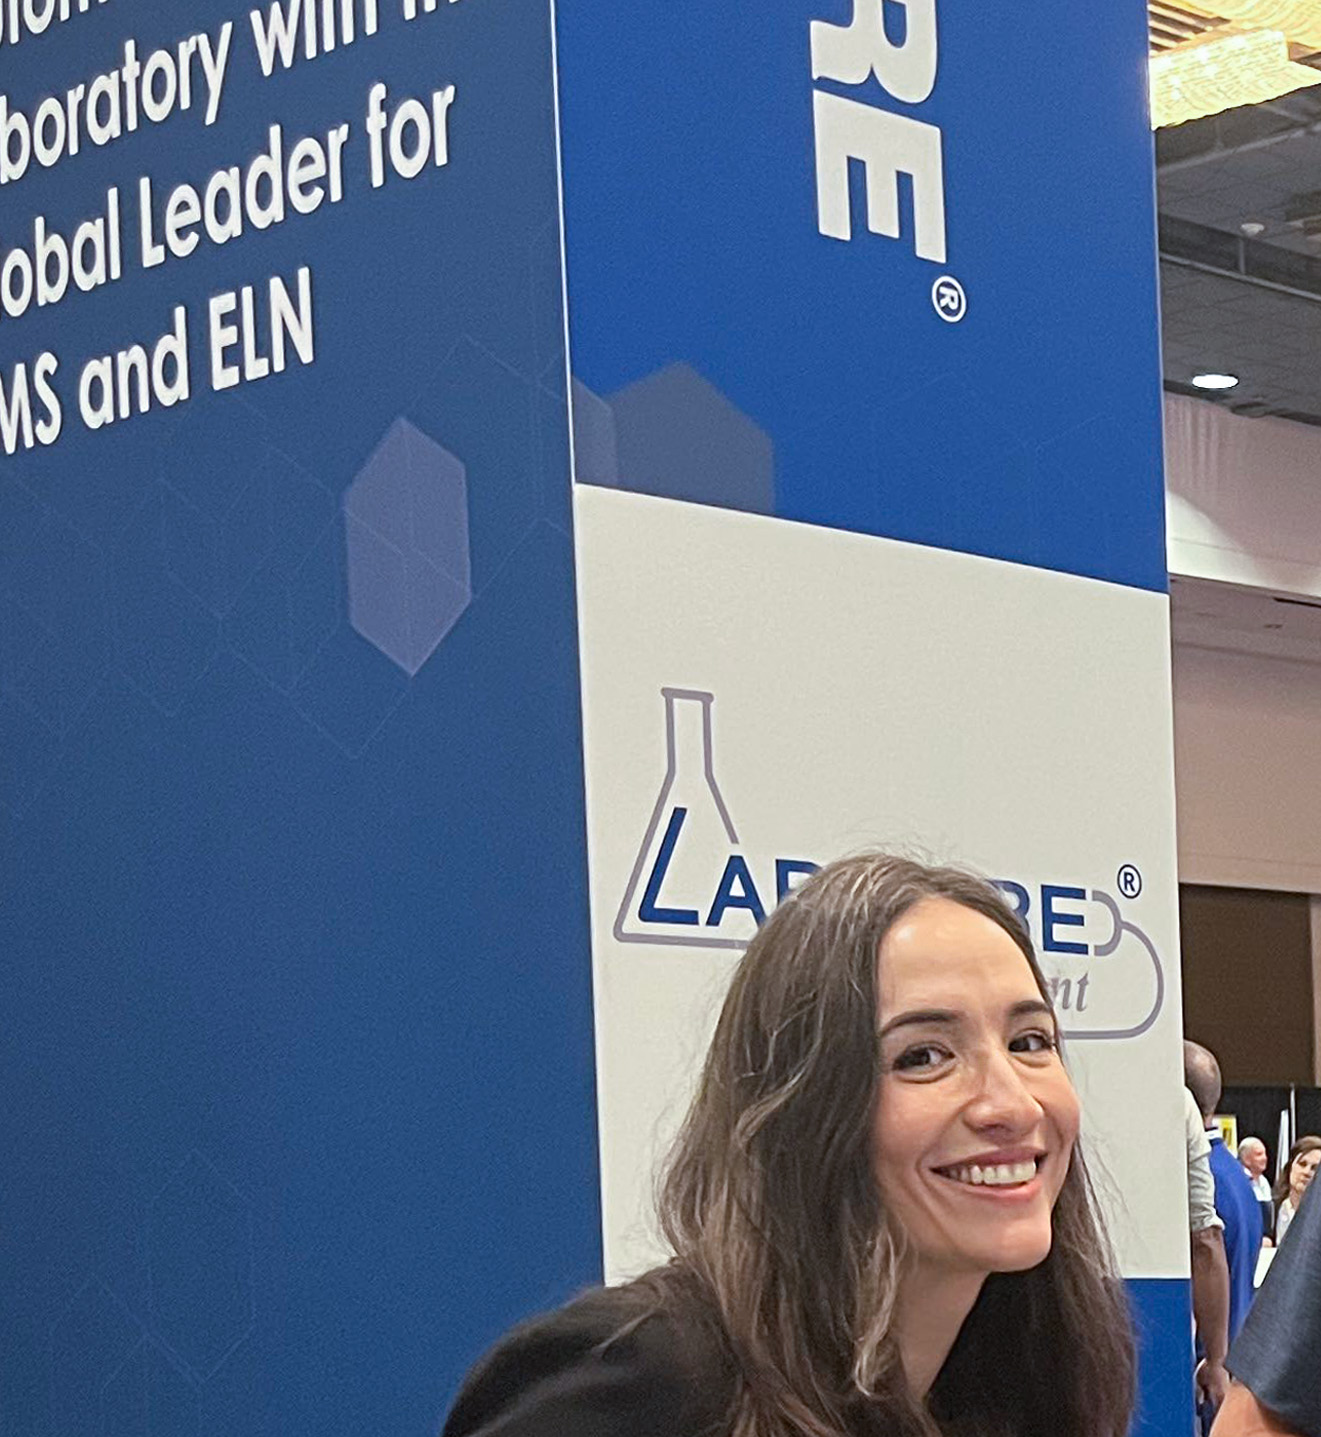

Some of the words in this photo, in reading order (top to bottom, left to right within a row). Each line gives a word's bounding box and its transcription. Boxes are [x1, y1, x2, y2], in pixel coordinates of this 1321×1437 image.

[1, 187, 121, 317] obal
[139, 123, 349, 268] Leader
[366, 82, 456, 188] for
[79, 305, 189, 429] and
[209, 266, 314, 391] ELN
